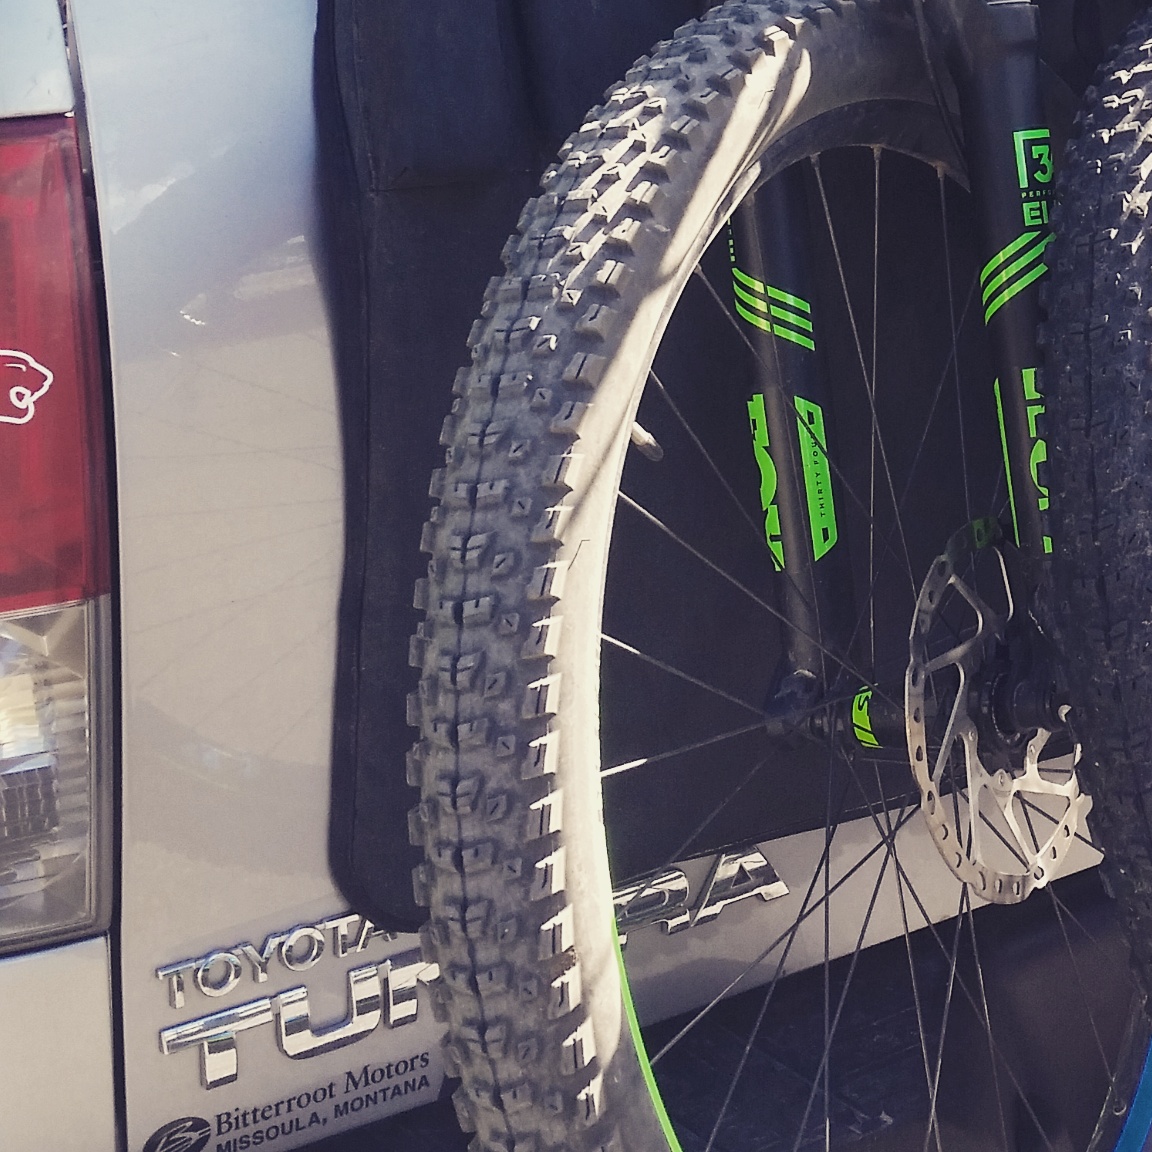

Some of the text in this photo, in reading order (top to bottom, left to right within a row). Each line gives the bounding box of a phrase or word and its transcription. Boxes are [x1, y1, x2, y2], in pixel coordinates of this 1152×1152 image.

[815, 470, 829, 518] THIRTY
[214, 1051, 431, 1137] Bitterroot Motors
[214, 1074, 431, 1152] MISSOULA, MONTANA
